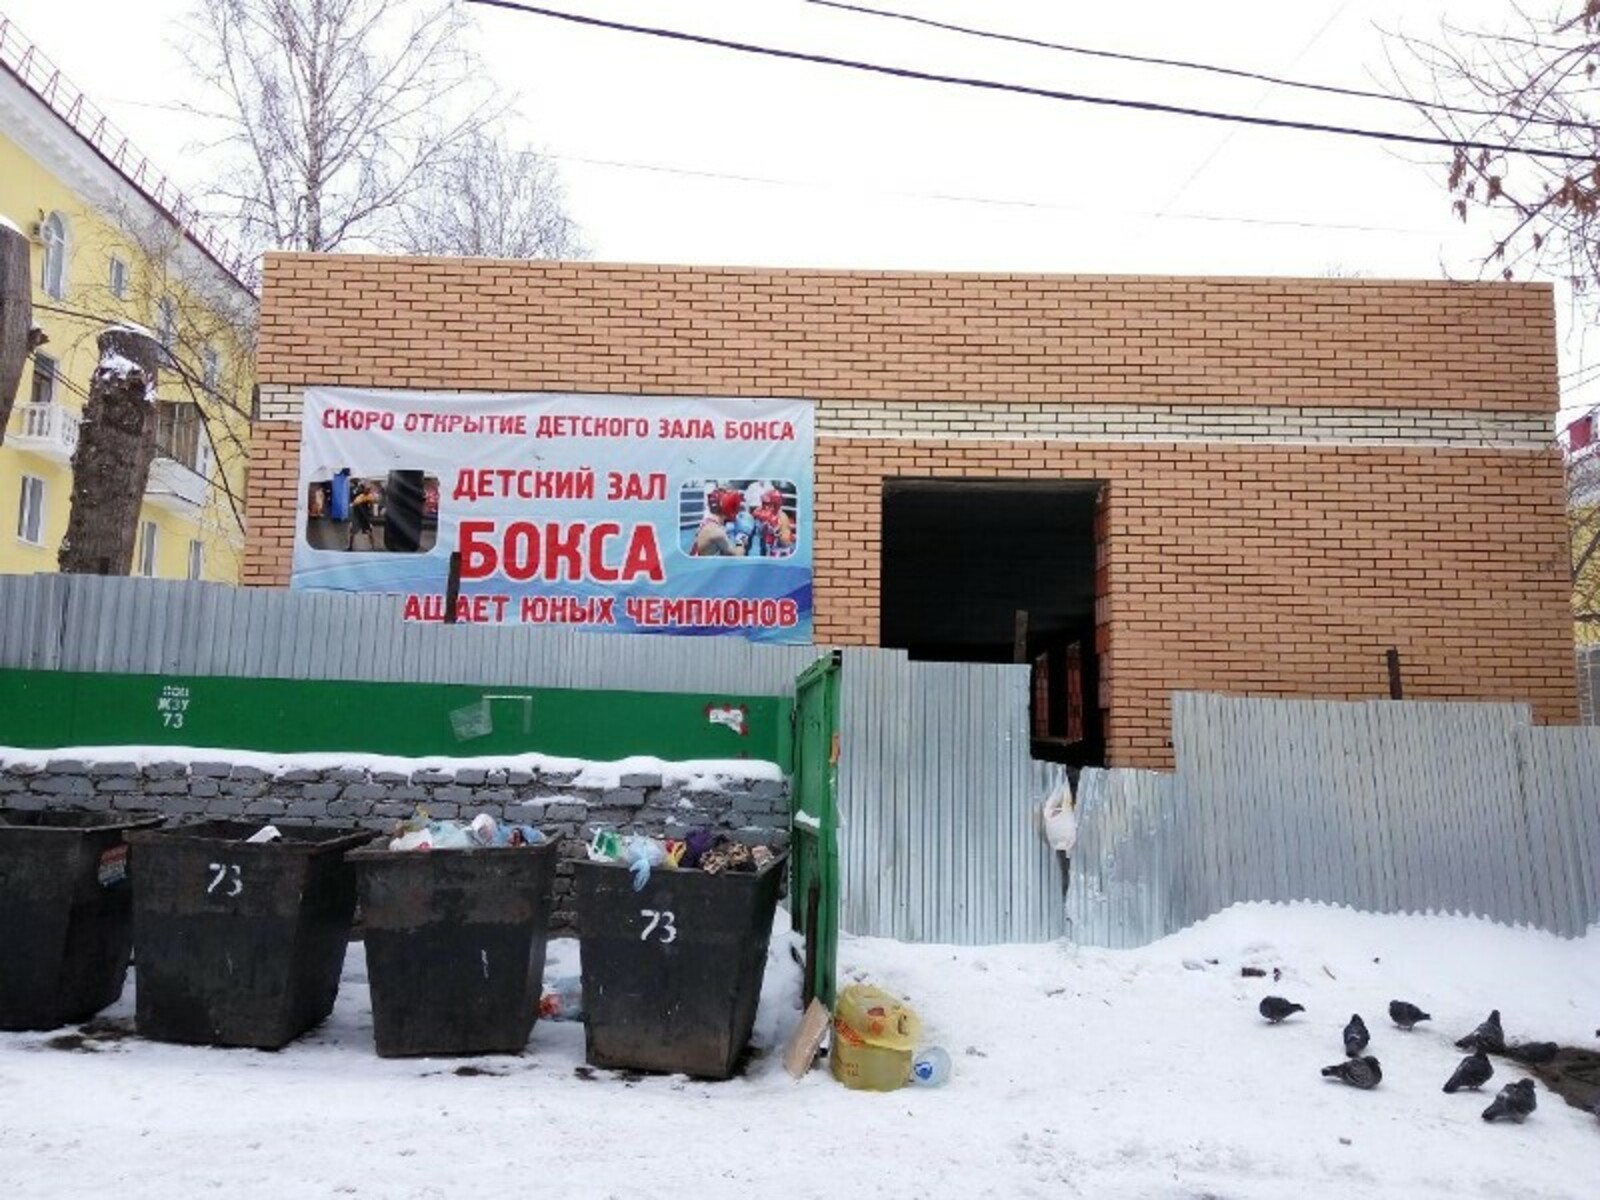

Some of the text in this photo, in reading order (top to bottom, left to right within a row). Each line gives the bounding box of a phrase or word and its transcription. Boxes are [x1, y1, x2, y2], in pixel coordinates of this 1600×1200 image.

[322, 408, 795, 441] СКОРО ОТКРЫТИЕ ДЕТСКОГО ЗАЛА БОКСА
[453, 467, 667, 502] ДЕТСКИЙ ЗАЛ
[459, 521, 664, 580] БОКСА
[521, 597, 615, 624] ЮНЫХ
[626, 598, 797, 626] ЧЕМПИОНОВ
[162, 712, 184, 729] 73
[208, 863, 243, 896] 73
[640, 909, 677, 943] 73
